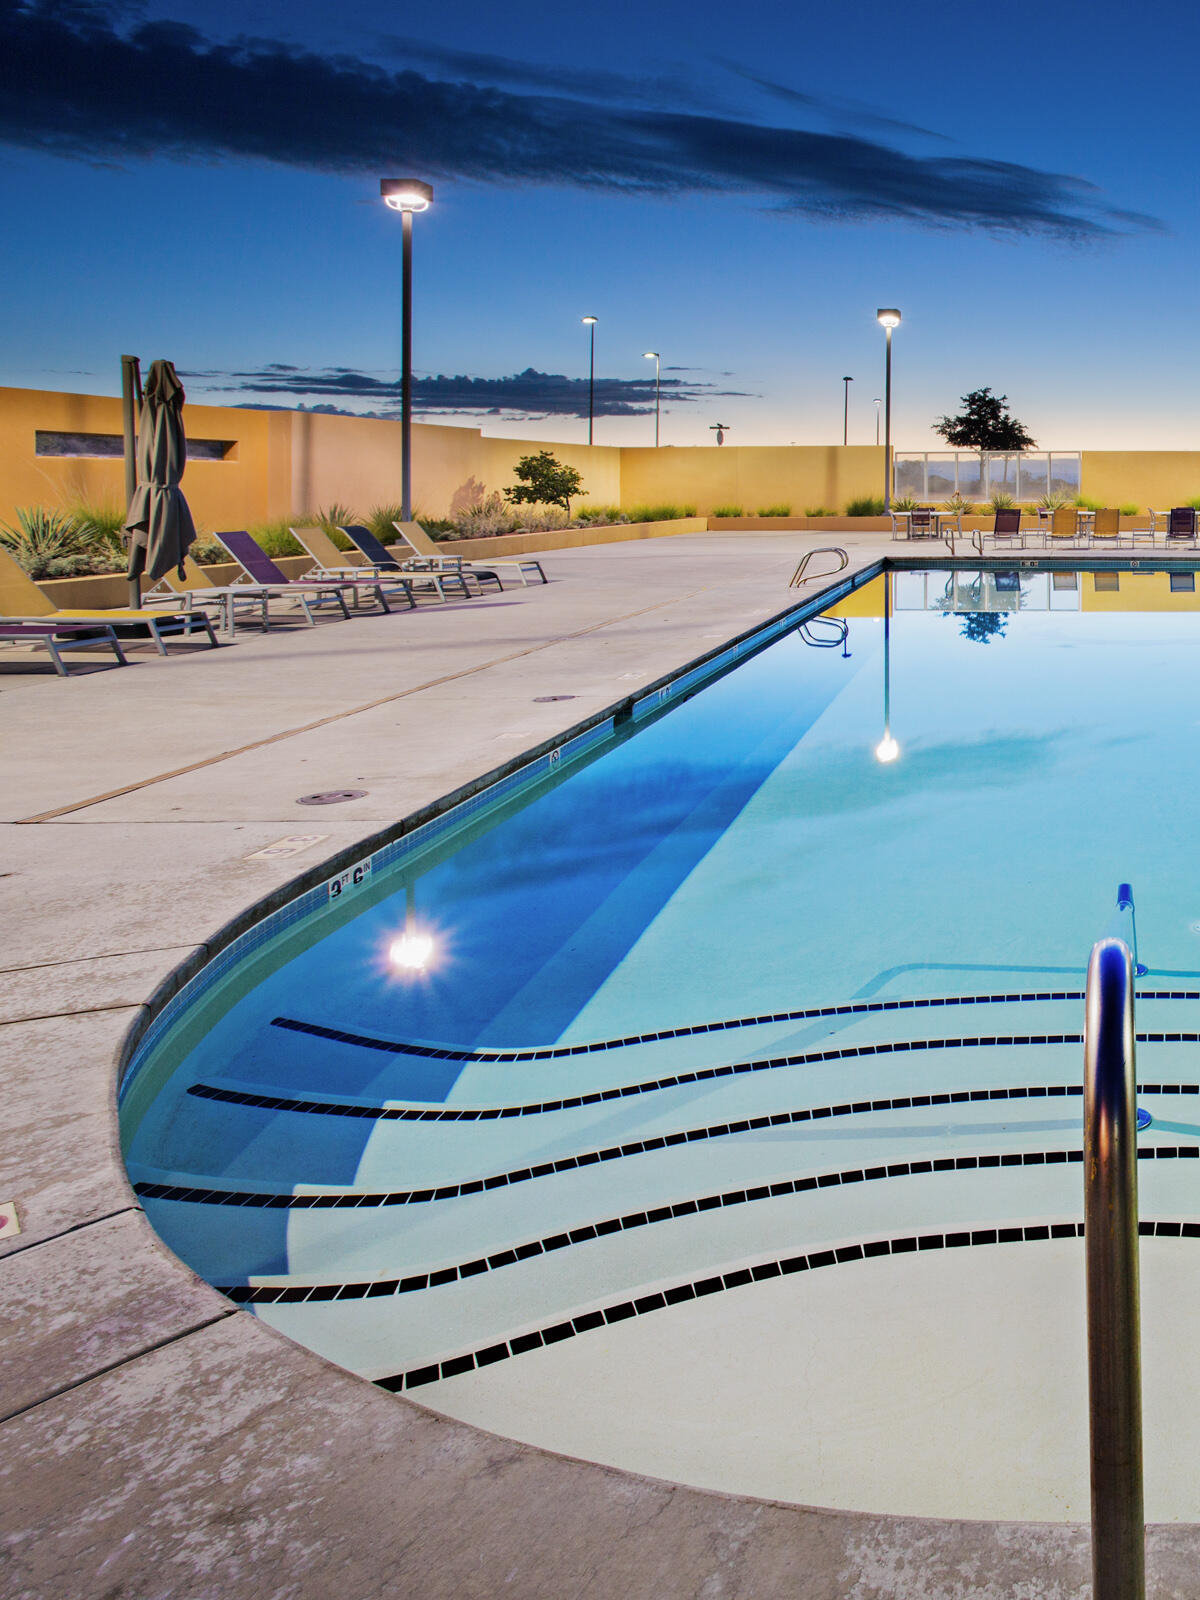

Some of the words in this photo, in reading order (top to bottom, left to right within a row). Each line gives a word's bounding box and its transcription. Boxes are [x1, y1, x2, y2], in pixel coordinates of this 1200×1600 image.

[331, 880, 342, 898] 3
[342, 873, 350, 886] FT
[363, 861, 371, 872] IN
